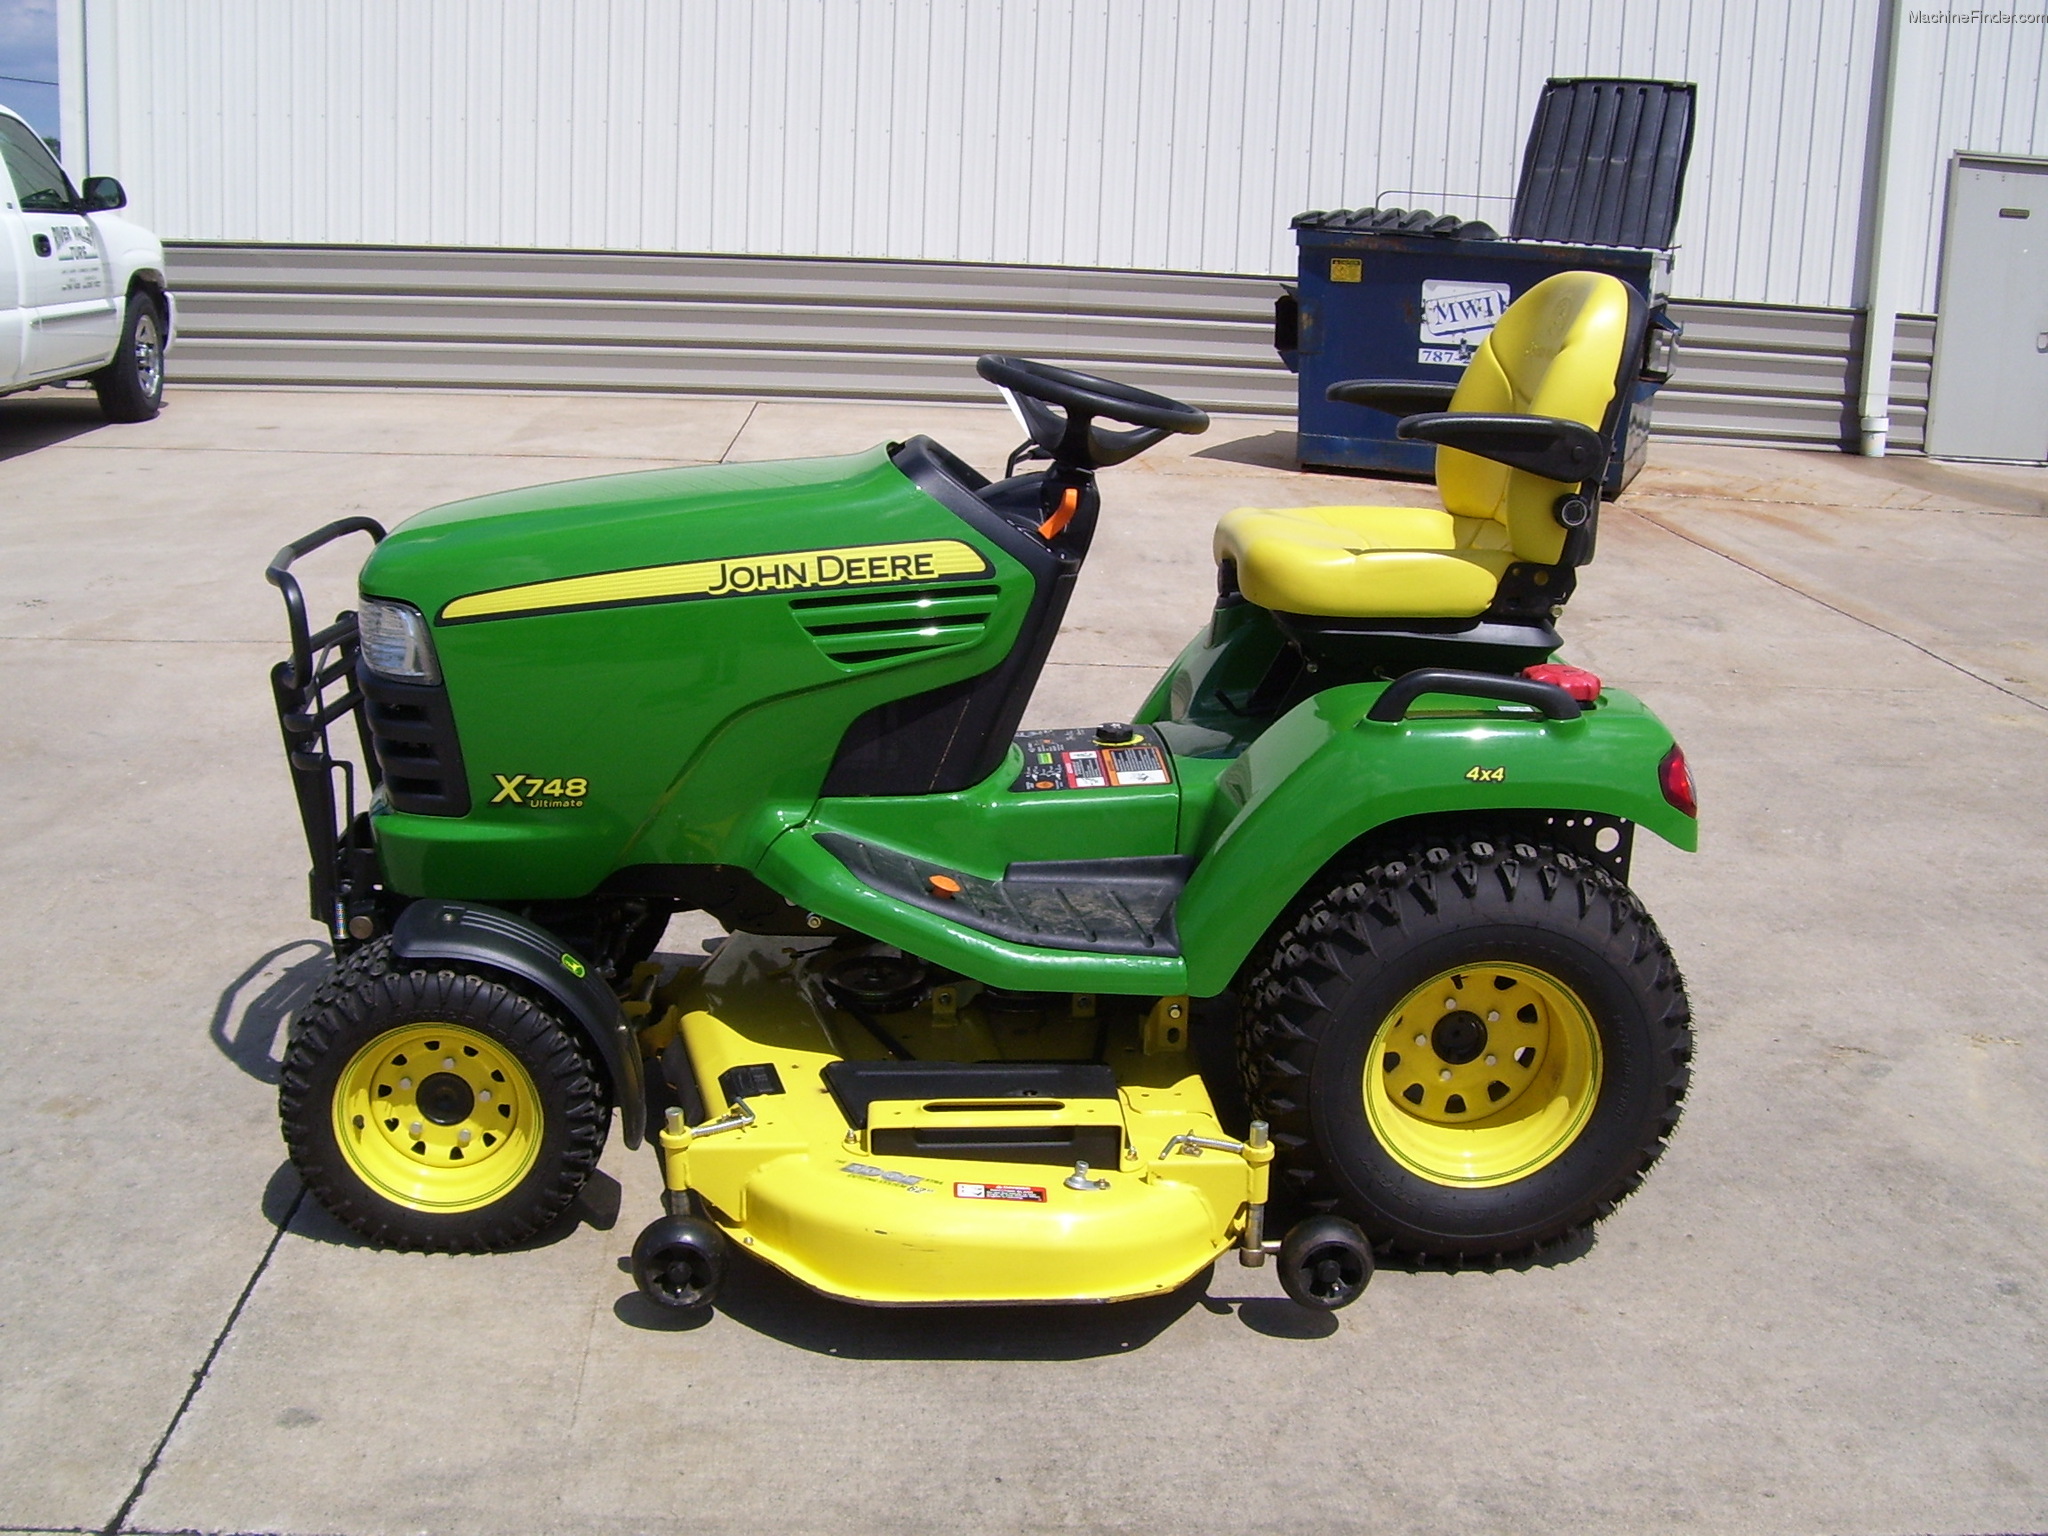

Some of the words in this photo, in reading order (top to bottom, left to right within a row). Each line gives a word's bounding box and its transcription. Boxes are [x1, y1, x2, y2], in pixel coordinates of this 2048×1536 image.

[708, 562, 806, 592] JOHN
[816, 553, 935, 583] DEERE
[1465, 766, 1505, 782] 4x4
[490, 774, 588, 803] X748
[530, 799, 583, 808] Ultimate
